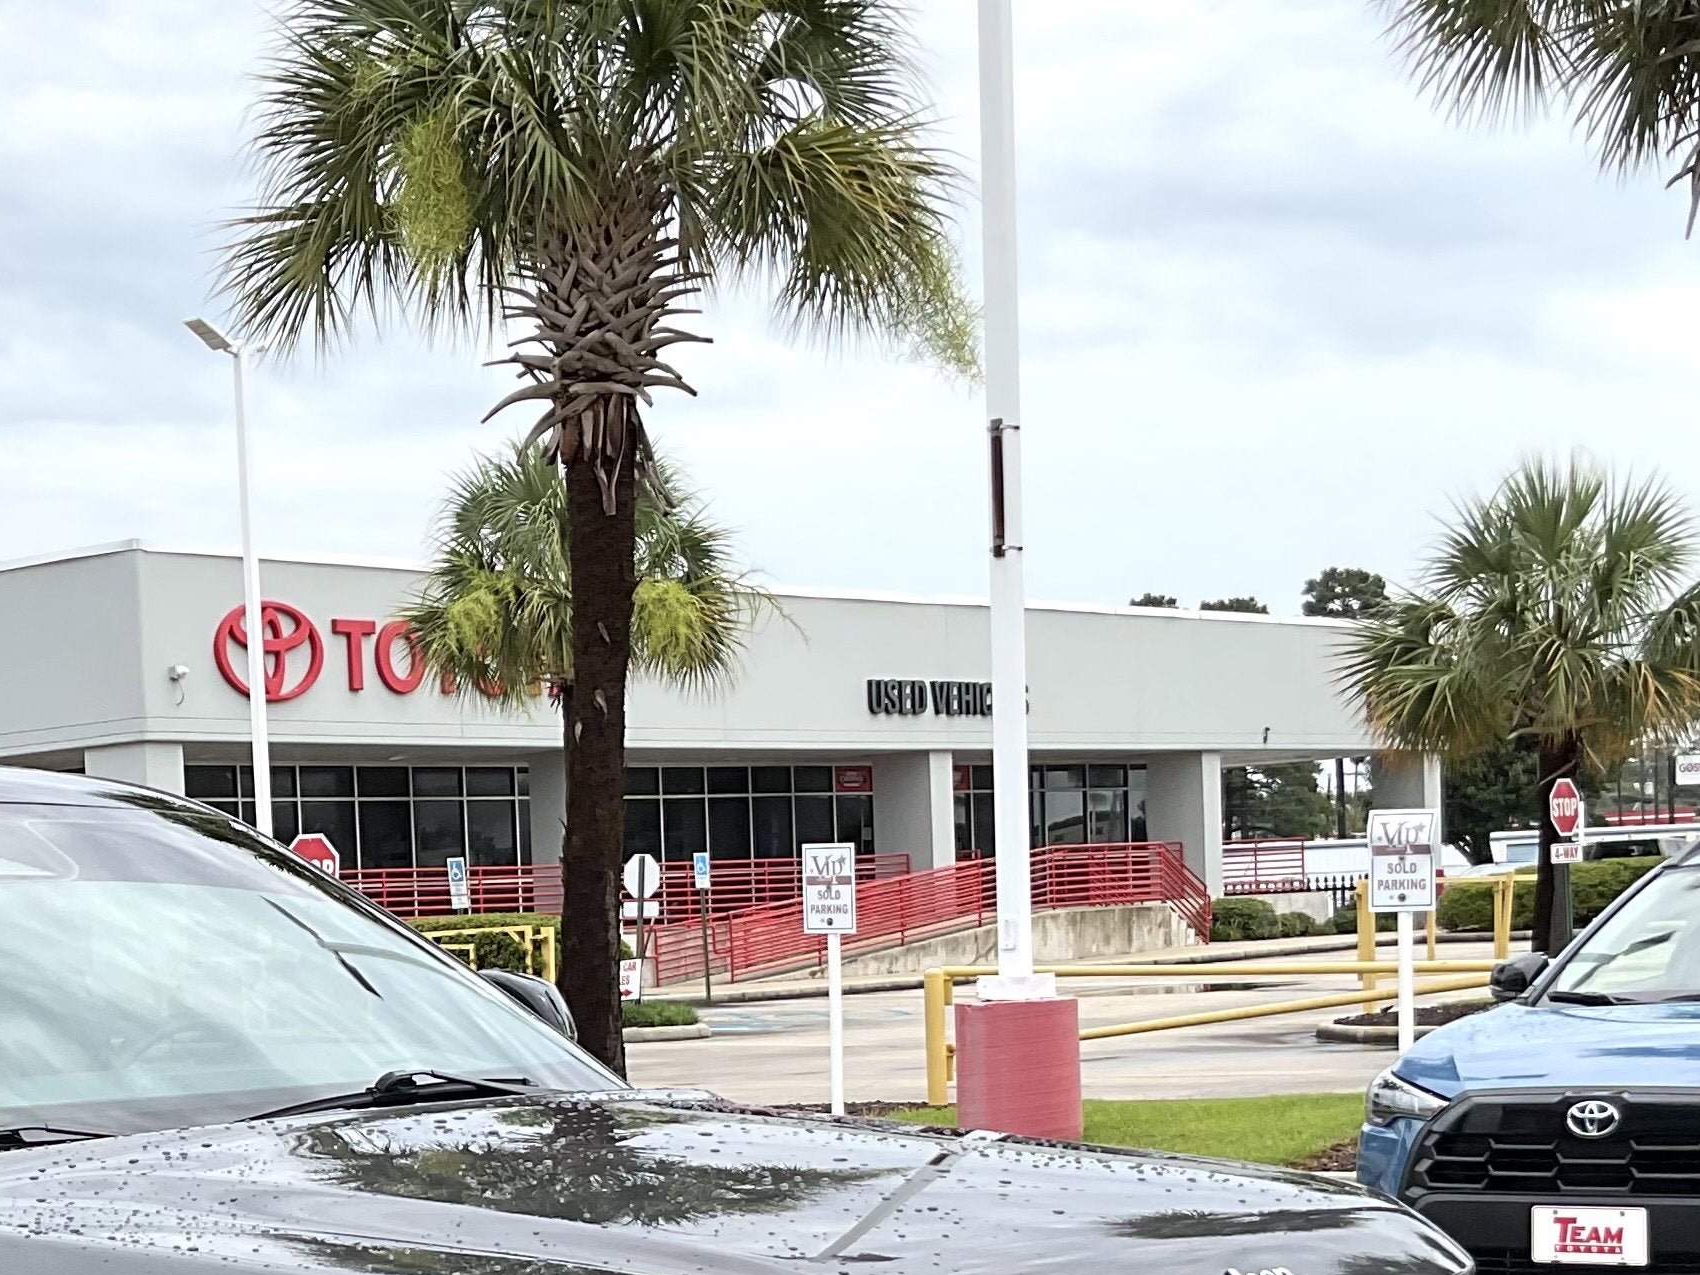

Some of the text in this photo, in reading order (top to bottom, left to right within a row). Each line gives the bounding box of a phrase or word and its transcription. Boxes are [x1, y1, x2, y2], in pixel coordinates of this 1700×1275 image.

[867, 679, 928, 715] USED
[1552, 797, 1577, 818] STOP
[1554, 845, 1578, 860] 4-WAY
[1387, 862, 1417, 874] SOLD
[1377, 878, 1427, 891] PARKING
[817, 889, 841, 901] SOLD
[810, 904, 849, 915] PARKING
[1555, 1245, 1622, 1254] TOYOTA
